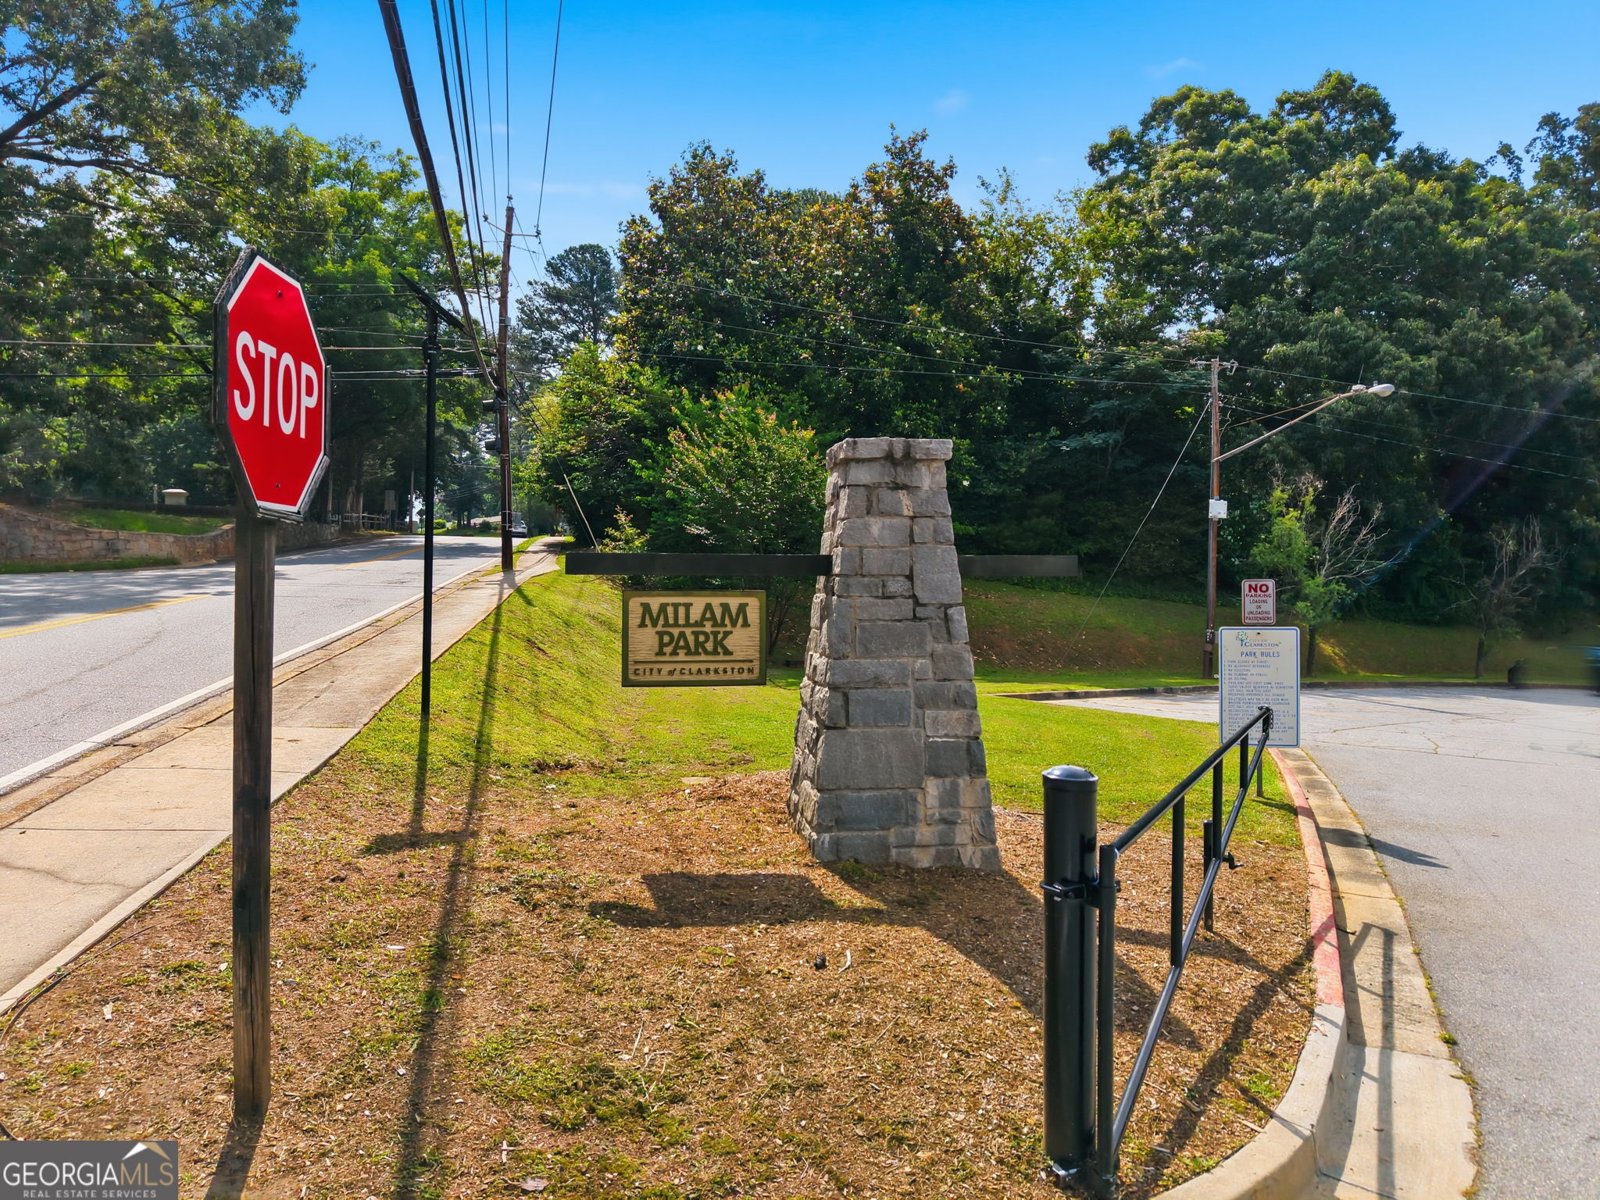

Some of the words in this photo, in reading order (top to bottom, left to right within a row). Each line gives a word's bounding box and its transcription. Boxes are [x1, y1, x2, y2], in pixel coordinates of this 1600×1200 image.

[233, 330, 319, 439] STOP
[1248, 583, 1269, 593] NO
[638, 602, 751, 628] MILAM
[655, 630, 734, 656] PARK
[633, 668, 663, 676] CITY
[667, 668, 677, 676] of
[679, 666, 755, 675] CLARKSTON
